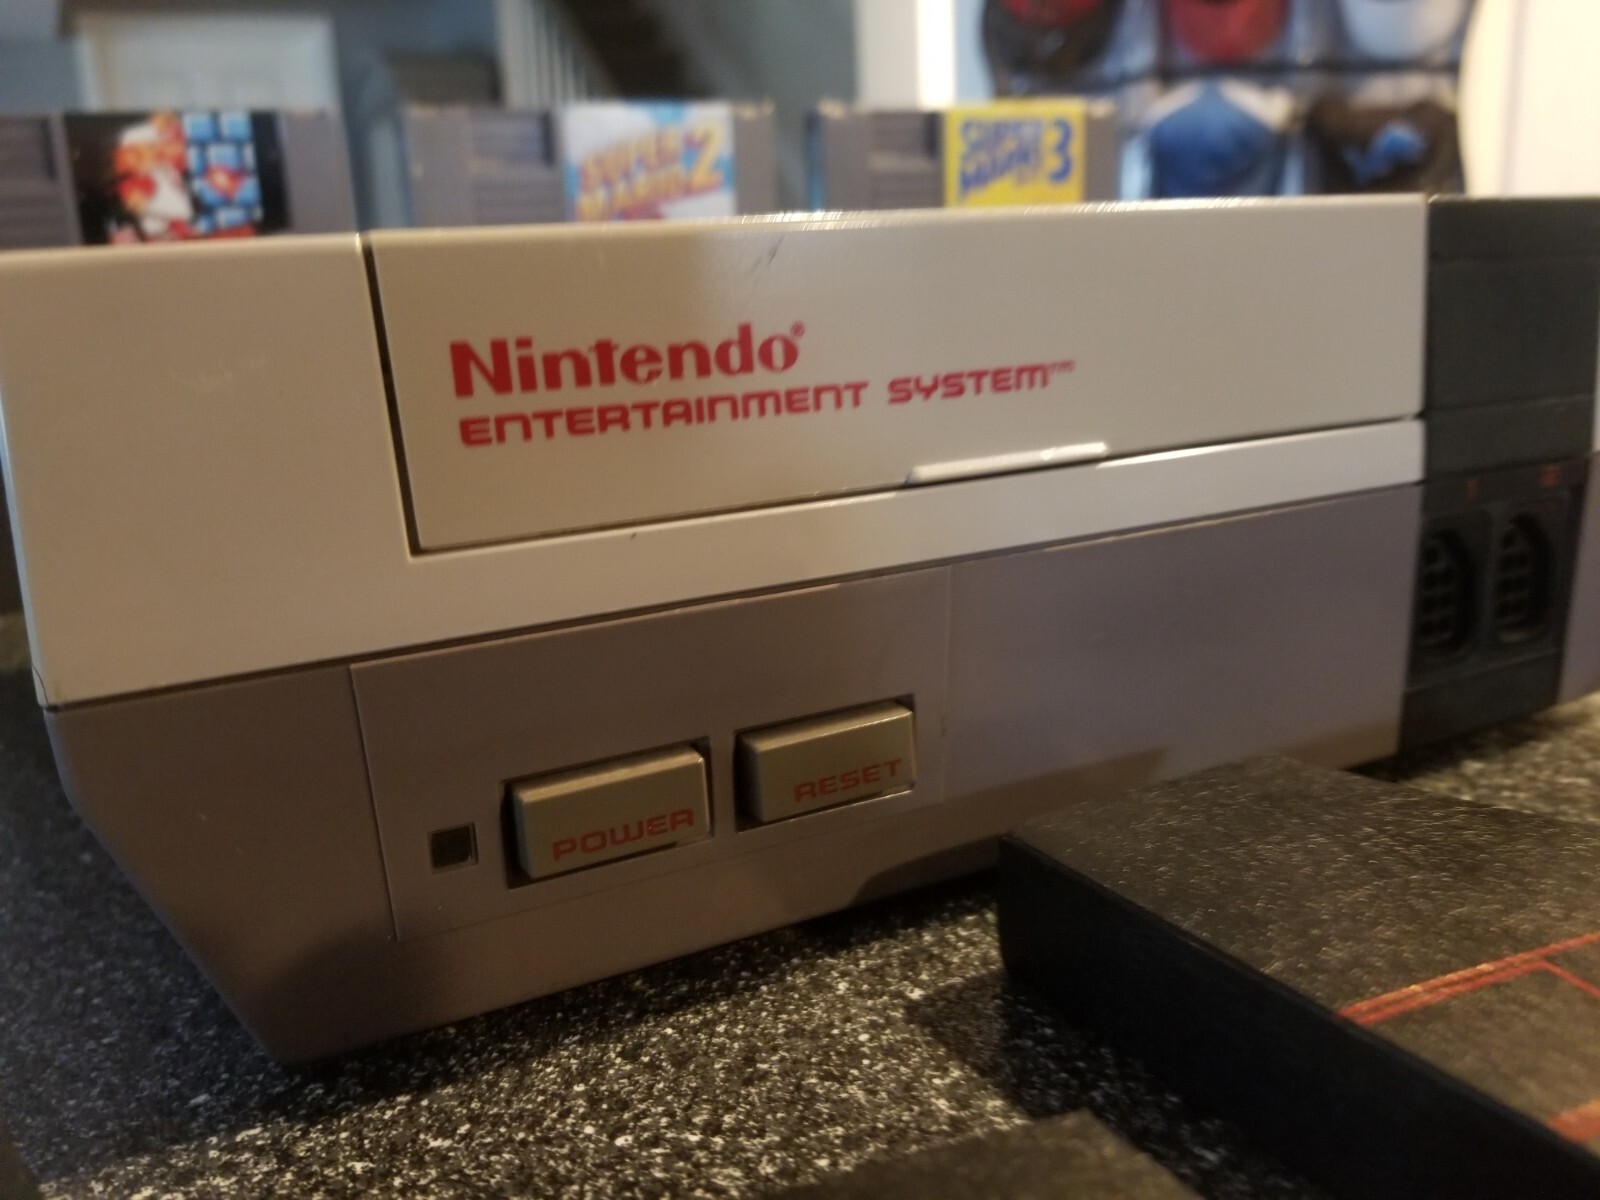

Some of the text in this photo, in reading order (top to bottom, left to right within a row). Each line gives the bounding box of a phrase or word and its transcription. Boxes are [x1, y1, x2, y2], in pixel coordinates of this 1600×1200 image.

[1048, 118, 1072, 184] 3
[458, 381, 869, 447] ENTERTAINMENT
[793, 758, 902, 804] RESET
[551, 808, 695, 862] POWER
